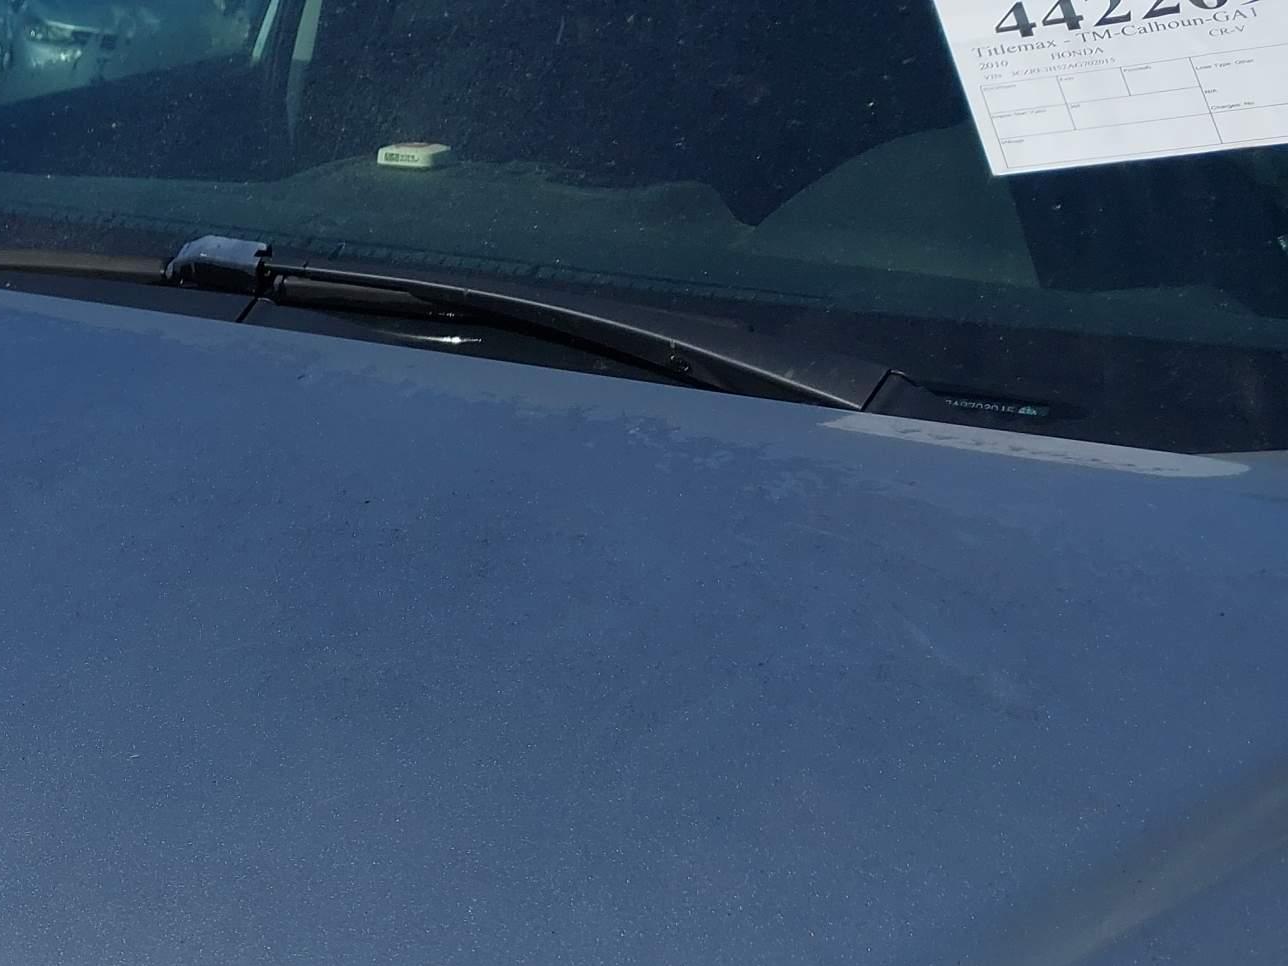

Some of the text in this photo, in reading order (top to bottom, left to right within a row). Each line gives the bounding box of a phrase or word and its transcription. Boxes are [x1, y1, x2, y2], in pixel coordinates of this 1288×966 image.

[971, 39, 1057, 57] Titlemax
[1076, 6, 1258, 43] TM-Calhoun-GA1
[978, 24, 1246, 71] 2010 HONDA CR-V
